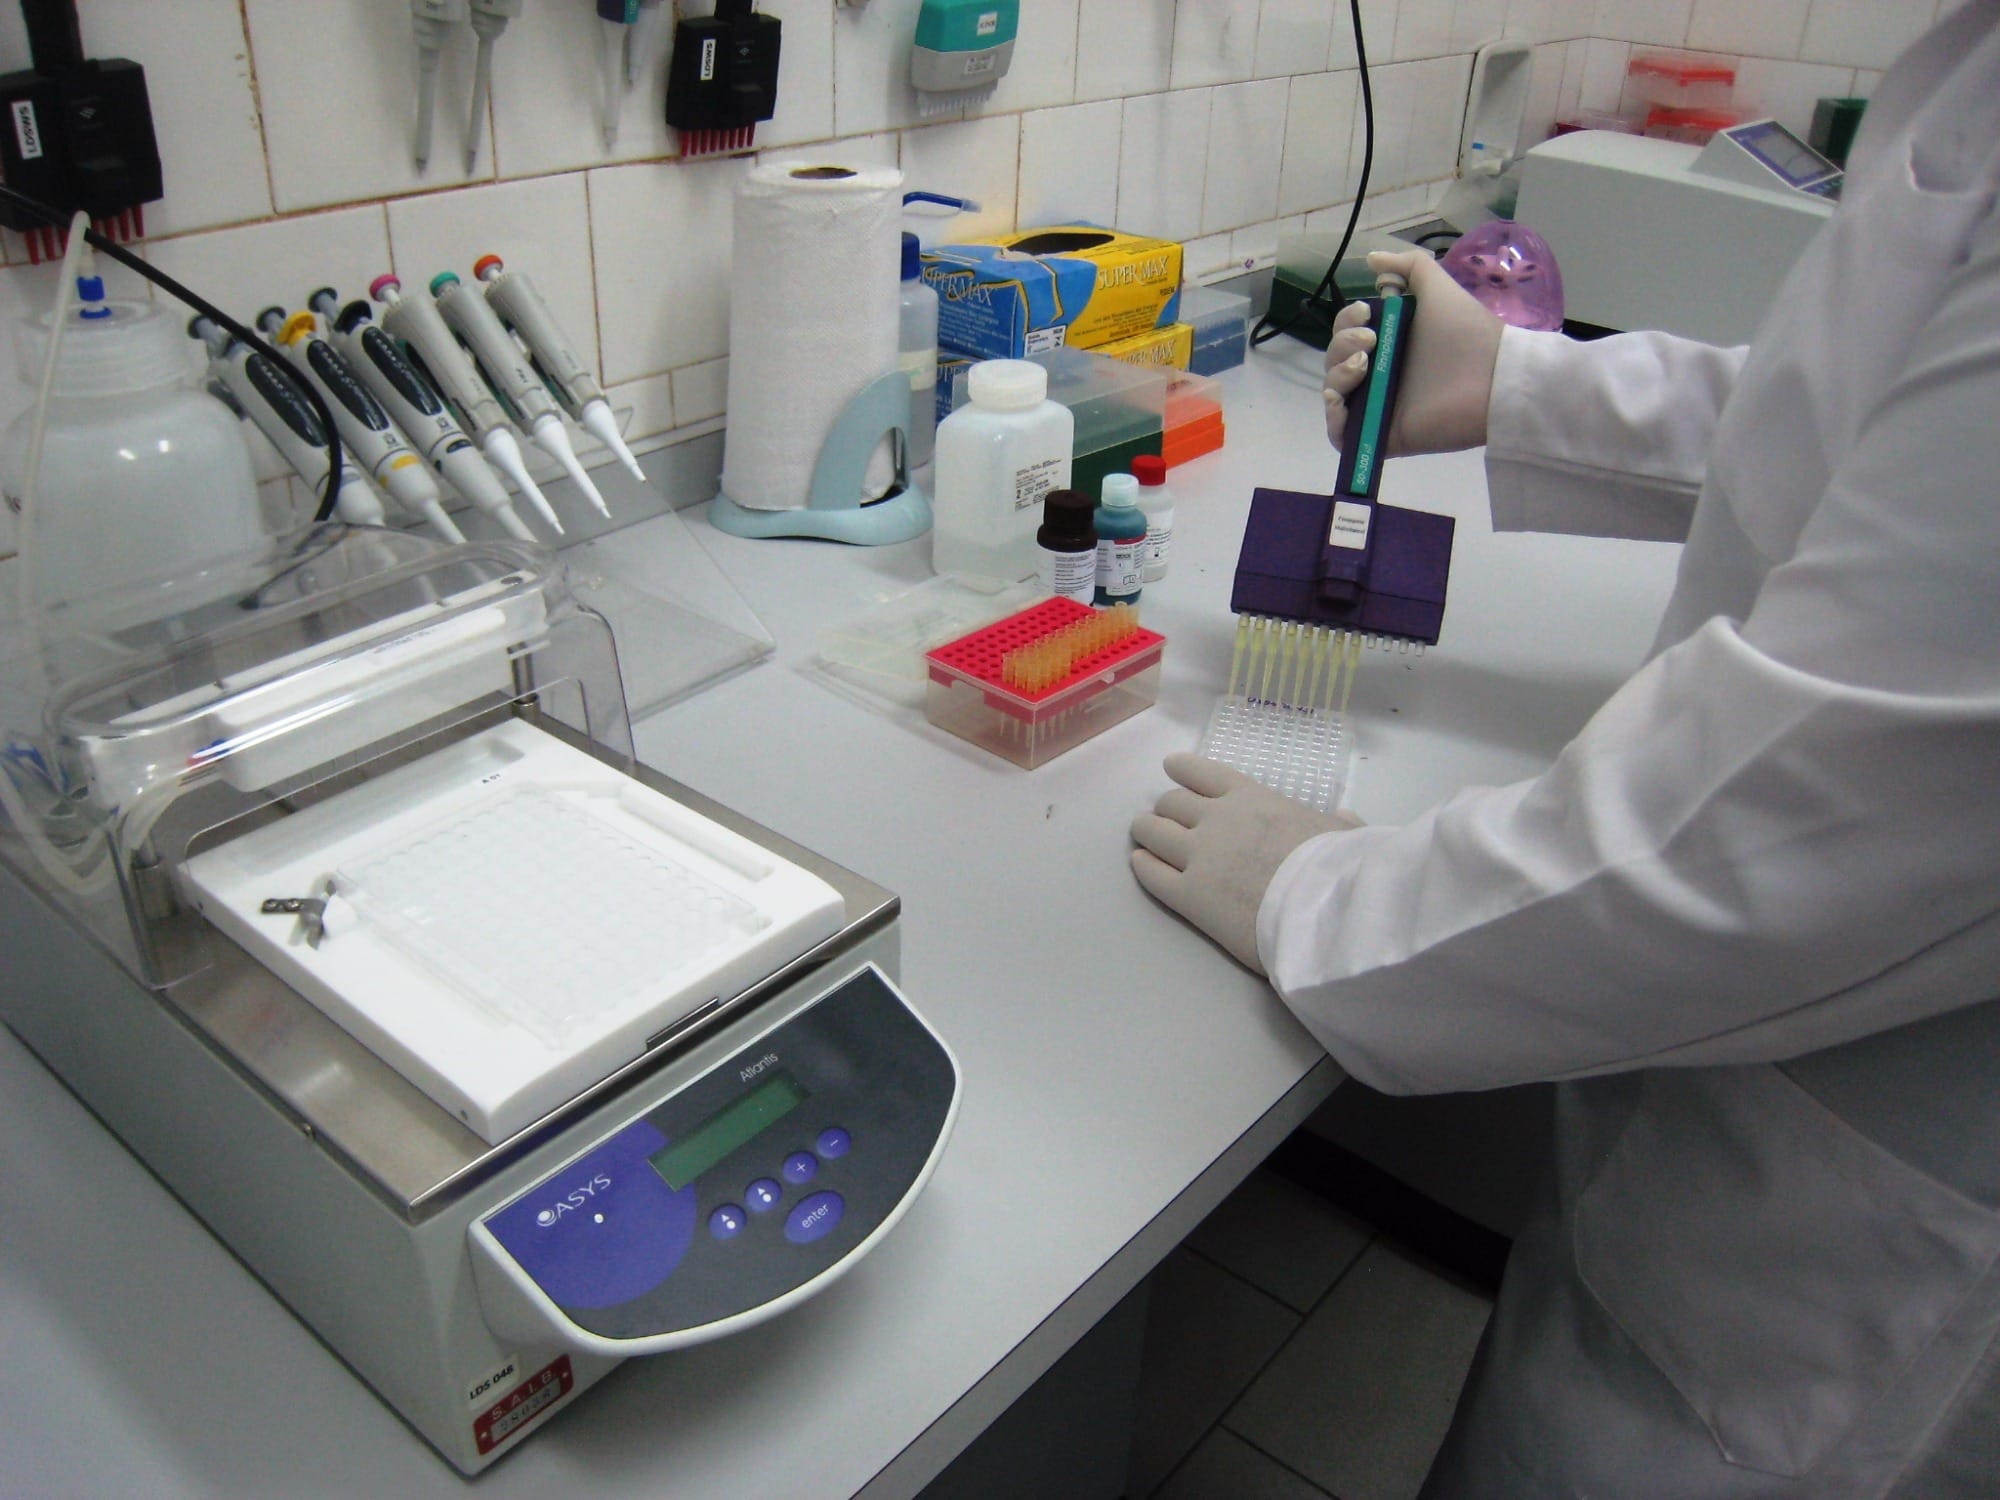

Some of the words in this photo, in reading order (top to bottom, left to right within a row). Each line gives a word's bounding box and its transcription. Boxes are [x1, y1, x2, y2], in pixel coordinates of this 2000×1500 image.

[1377, 313, 1397, 373] Finnpipette
[739, 1052, 779, 1082] Atlantis
[801, 1203, 829, 1228] enter
